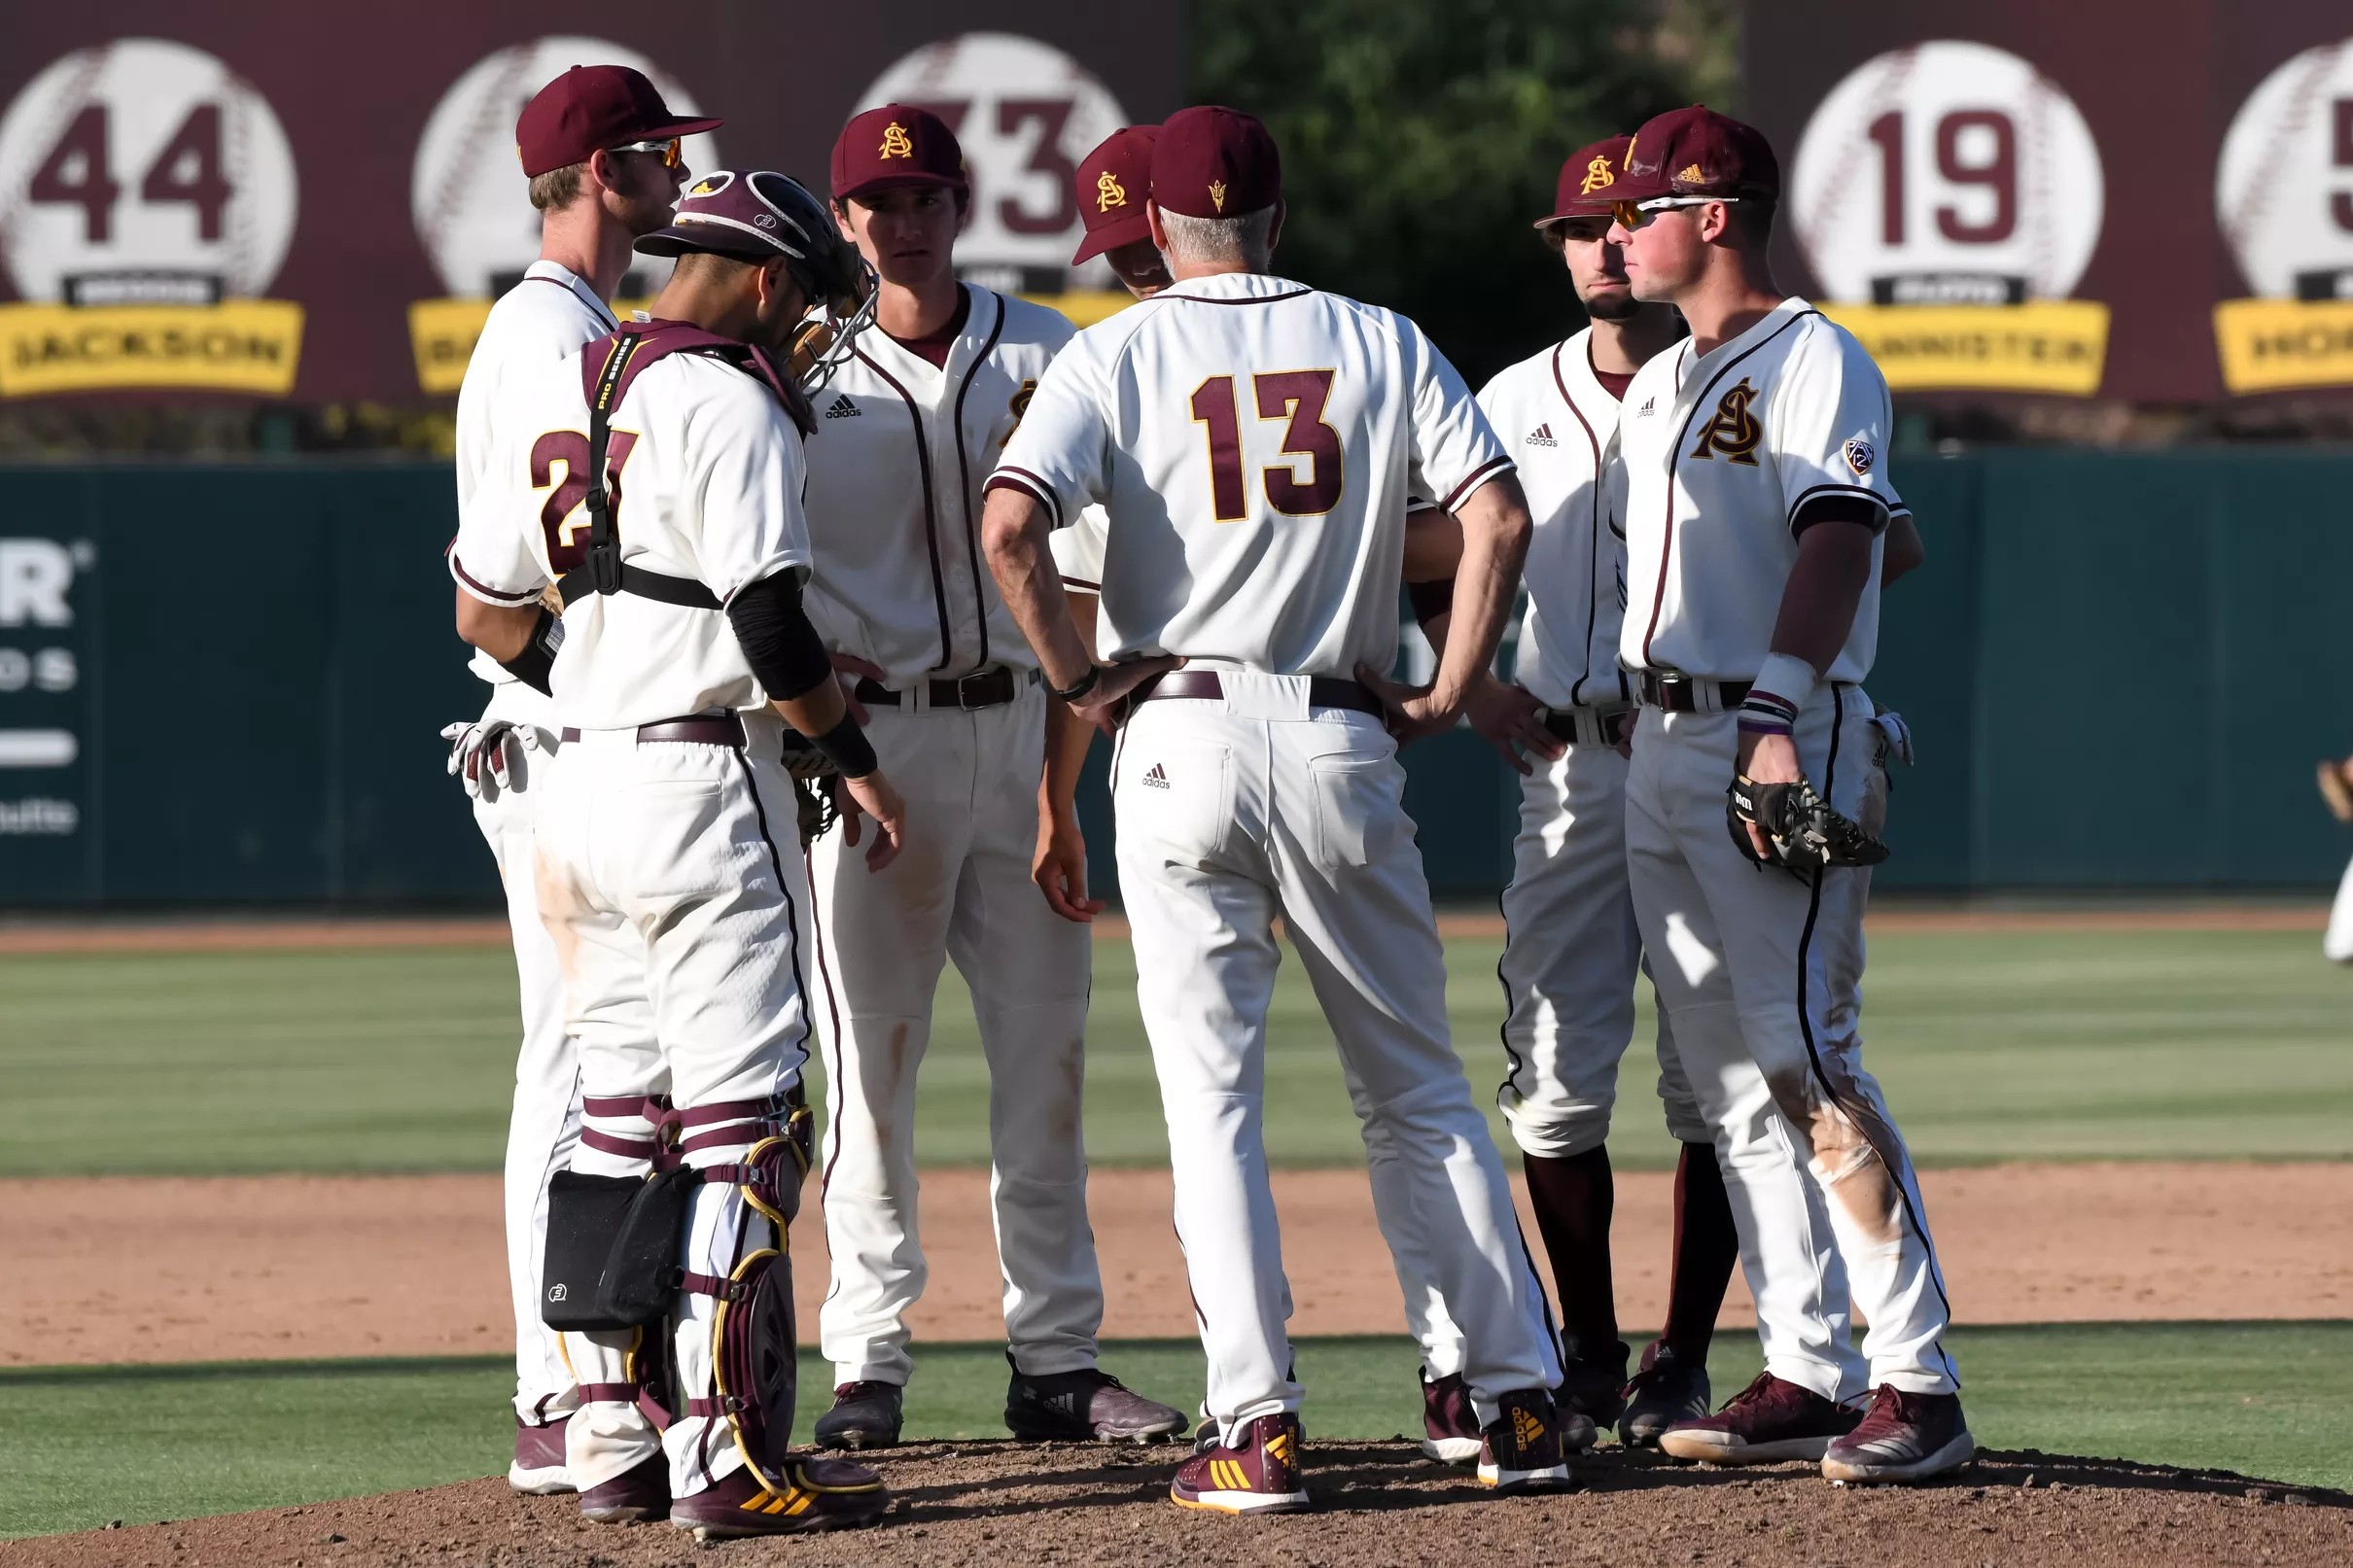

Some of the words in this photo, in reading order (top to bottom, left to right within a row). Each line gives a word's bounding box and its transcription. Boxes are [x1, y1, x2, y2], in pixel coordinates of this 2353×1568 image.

[29, 103, 235, 243] 44
[1868, 109, 2019, 247] 19
[14, 327, 284, 371] JACKSON
[598, 383, 613, 410] PRO
[608, 337, 632, 380] SERIES
[825, 408, 861, 419] adidas
[1189, 367, 1344, 523] 13
[1526, 436, 1559, 447] adidas
[1846, 440, 1873, 464] PAC
[1852, 454, 1868, 468] 12
[530, 428, 642, 578] 27
[1141, 775, 1172, 789] adidas
[1512, 1407, 1528, 1451] adidas
